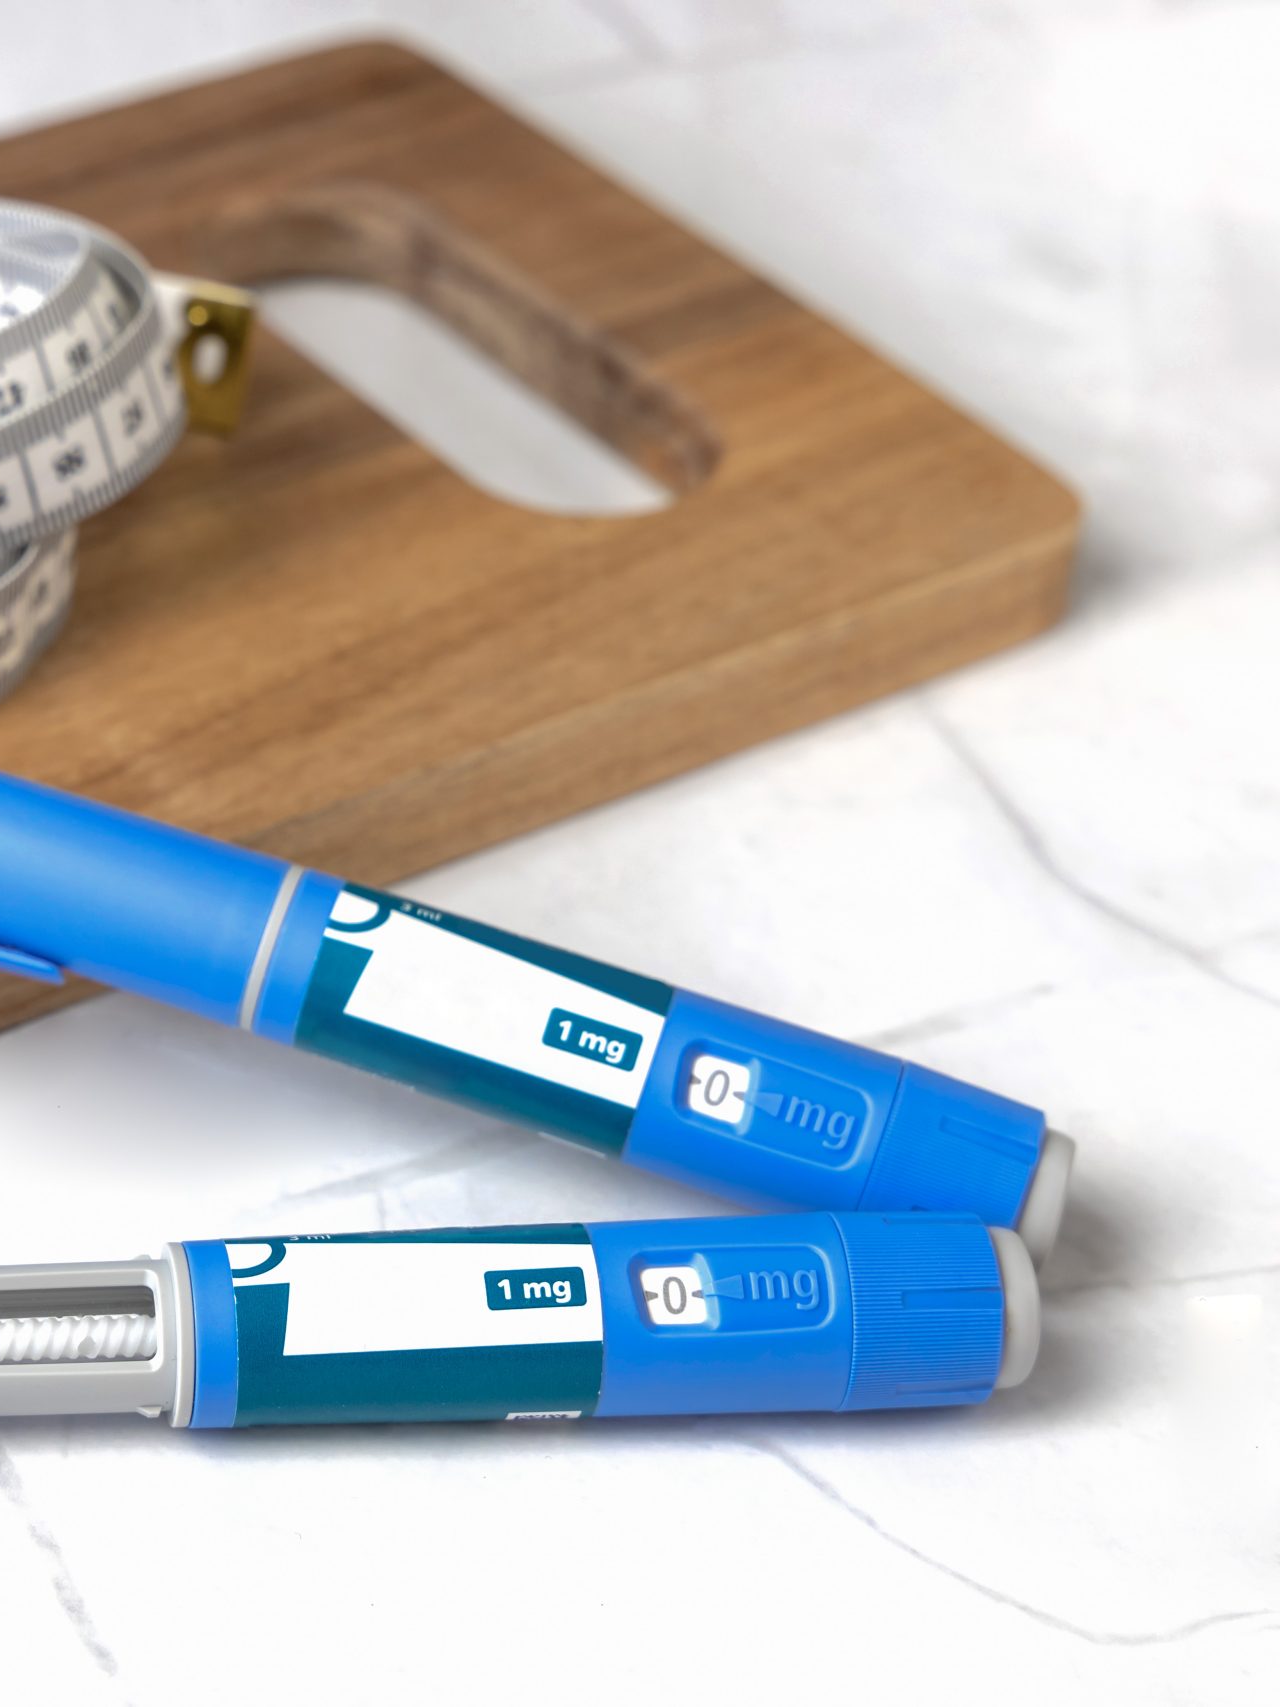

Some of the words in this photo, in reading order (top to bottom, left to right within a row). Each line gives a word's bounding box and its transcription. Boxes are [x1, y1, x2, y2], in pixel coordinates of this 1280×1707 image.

[559, 1020, 572, 1042] 1
[578, 1030, 626, 1064] mg
[703, 1069, 730, 1106] 0
[784, 1095, 855, 1150] mg
[497, 1278, 512, 1300] 1
[523, 1280, 572, 1304] mg
[662, 1276, 687, 1315] 0
[749, 1269, 820, 1310] mg
